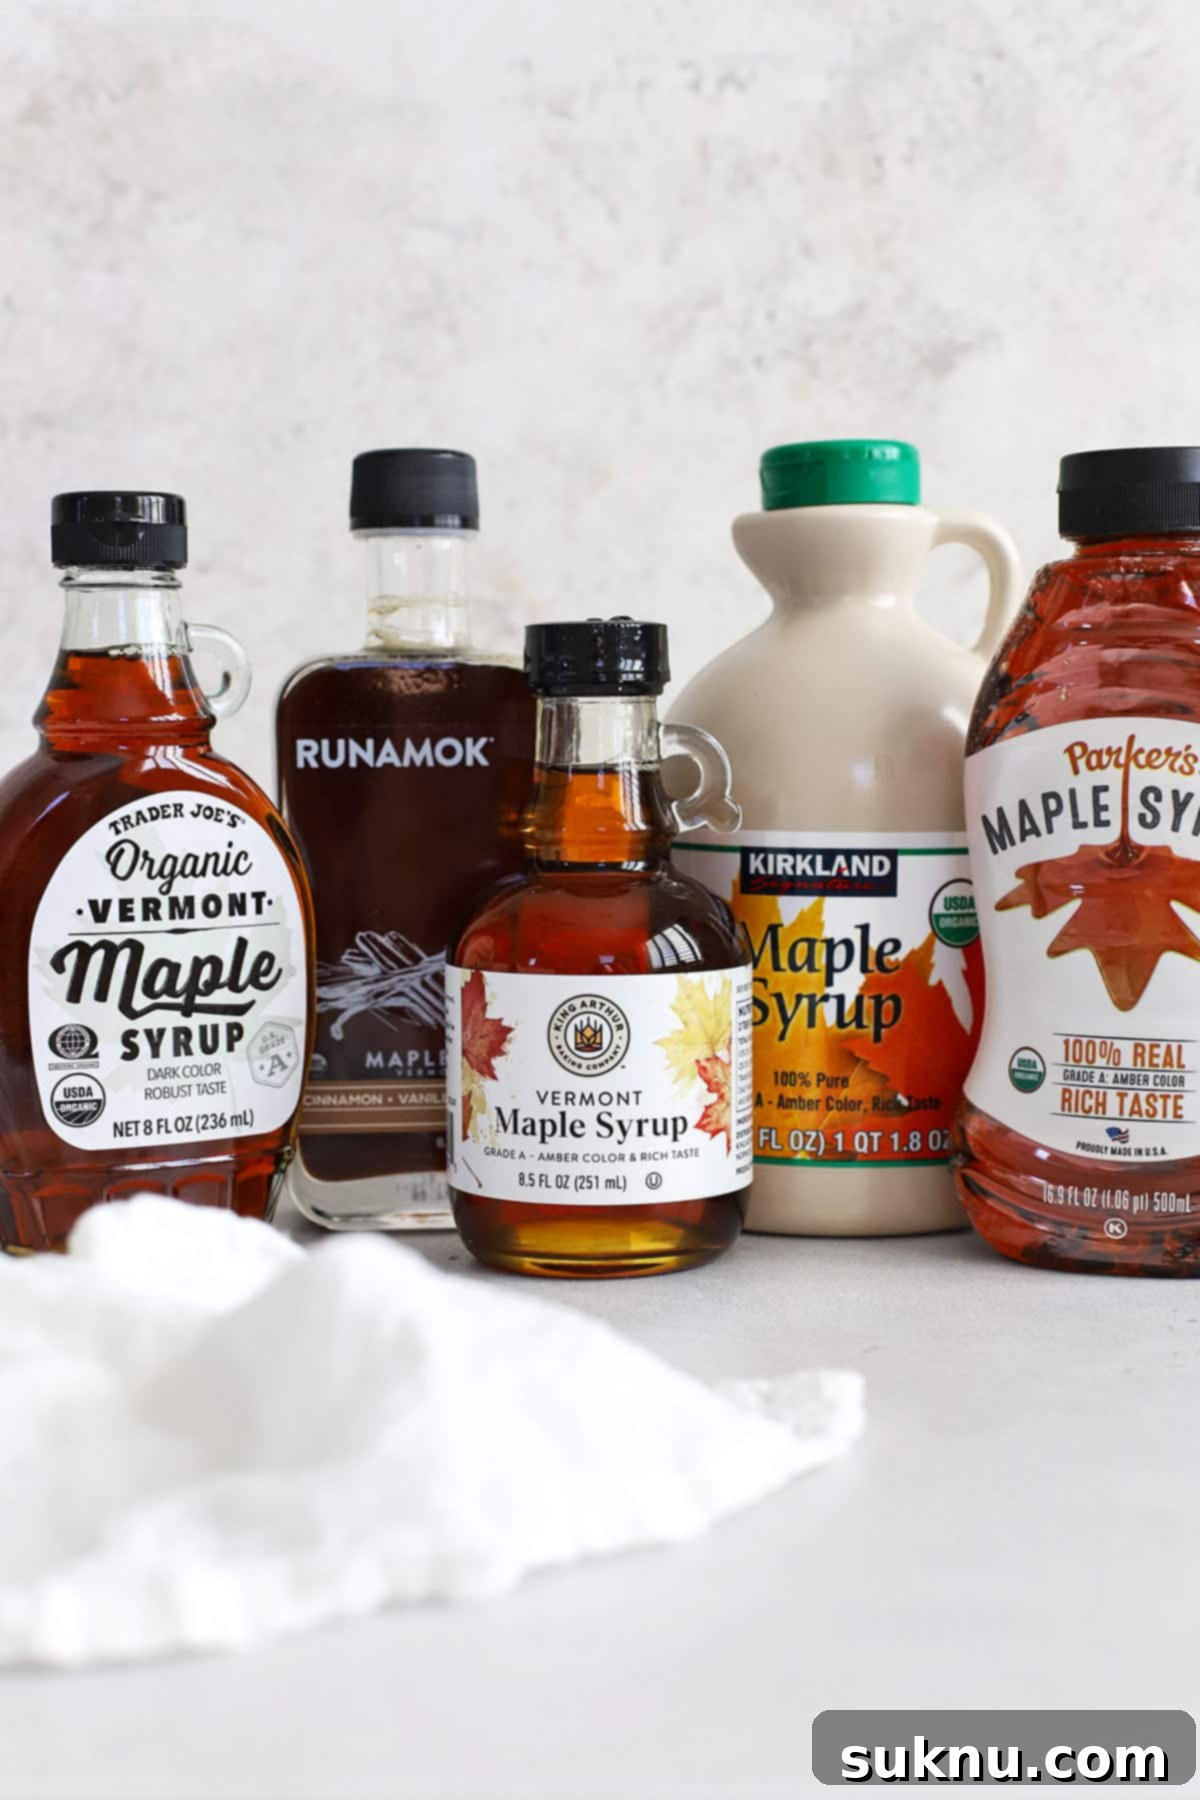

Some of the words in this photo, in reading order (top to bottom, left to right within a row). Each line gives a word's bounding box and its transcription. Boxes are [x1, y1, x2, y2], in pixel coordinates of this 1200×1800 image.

[295, 737, 489, 769] RUNAMOK
[1063, 734, 1199, 776] Parker's
[108, 802, 185, 836] TRADER
[189, 803, 241, 829] JOE'S
[981, 784, 1111, 856] MAPLE
[1137, 785, 1200, 838] SY
[105, 838, 253, 896] Organic
[749, 853, 891, 877] KIRKLAND
[747, 874, 875, 894] Signature
[88, 891, 267, 924] VERMONT
[943, 895, 975, 911] USDA
[741, 920, 903, 987] Maple
[50, 936, 283, 1021] Maple
[553, 1003, 577, 1033] KING
[580, 999, 624, 1032] ARTHUR
[752, 977, 904, 1044] Syrup
[120, 1022, 245, 1062] SYRUP
[1062, 1038, 1122, 1067] 100%
[1132, 1042, 1186, 1070] REAL
[267, 1054, 288, 1077] A
[365, 1050, 448, 1069] MAPLE
[556, 1044, 583, 1069] BAKING
[585, 1044, 621, 1071] COMPANY
[1016, 1057, 1038, 1070] USDA
[146, 1066, 181, 1082] DARK
[182, 1063, 222, 1080] COLOR
[773, 1071, 812, 1088] 100%
[816, 1072, 850, 1089] Pure
[1013, 1071, 1040, 1082] ORGANIC
[1062, 1068, 1095, 1083] GRADE
[1098, 1072, 1109, 1084] A:
[1112, 1072, 1149, 1087] AMBER
[1153, 1074, 1185, 1088] COLOR
[63, 1086, 94, 1099] USDA
[144, 1083, 193, 1101] ROBUST
[195, 1081, 227, 1097] TASTE
[303, 1093, 383, 1107] CINNAMON
[536, 1090, 643, 1107] VERMONT
[754, 1091, 764, 1108] A
[777, 1093, 820, 1111] Amber
[825, 1095, 868, 1114] Color,
[906, 1095, 941, 1111] Taste
[59, 1101, 98, 1113] ORGANIC
[1060, 1087, 1108, 1116] RICH
[1116, 1091, 1184, 1120] TASTE
[113, 1119, 141, 1139] NET
[143, 1119, 153, 1137] 8
[156, 1119, 172, 1135] FL
[174, 1117, 193, 1133] OZ
[195, 1114, 227, 1133] (236
[229, 1109, 255, 1129] mL)
[494, 1106, 587, 1145] Maple
[595, 1110, 688, 1145] Syrup
[758, 1127, 782, 1150] FL
[789, 1129, 825, 1156] OZ)
[833, 1130, 844, 1152] 1
[854, 1130, 883, 1153] QT
[890, 1130, 921, 1152] 1.8
[1075, 1140, 1109, 1155] PROUDLY
[1110, 1146, 1133, 1157] MADE
[1134, 1147, 1143, 1157] IN
[1145, 1147, 1169, 1156] U.S.A.
[484, 1145, 516, 1160] GRADE
[517, 1149, 527, 1161] A
[537, 1150, 579, 1163] AMBER
[582, 1150, 627, 1164] COLOR
[629, 1151, 638, 1163] &
[639, 1150, 669, 1162] RICH
[671, 1147, 700, 1159] TASTE
[518, 1171, 536, 1188] 8.5
[538, 1172, 553, 1189] FL
[555, 1172, 570, 1190] OZ
[574, 1172, 600, 1192] (251
[604, 1172, 627, 1192] mL)
[1042, 1183, 1065, 1204] 16.9
[1067, 1186, 1079, 1205] FL
[1083, 1187, 1098, 1208] OZ
[1101, 1189, 1130, 1210] (1.06
[1132, 1191, 1149, 1215] pt)
[1152, 1191, 1192, 1213] 500mL
